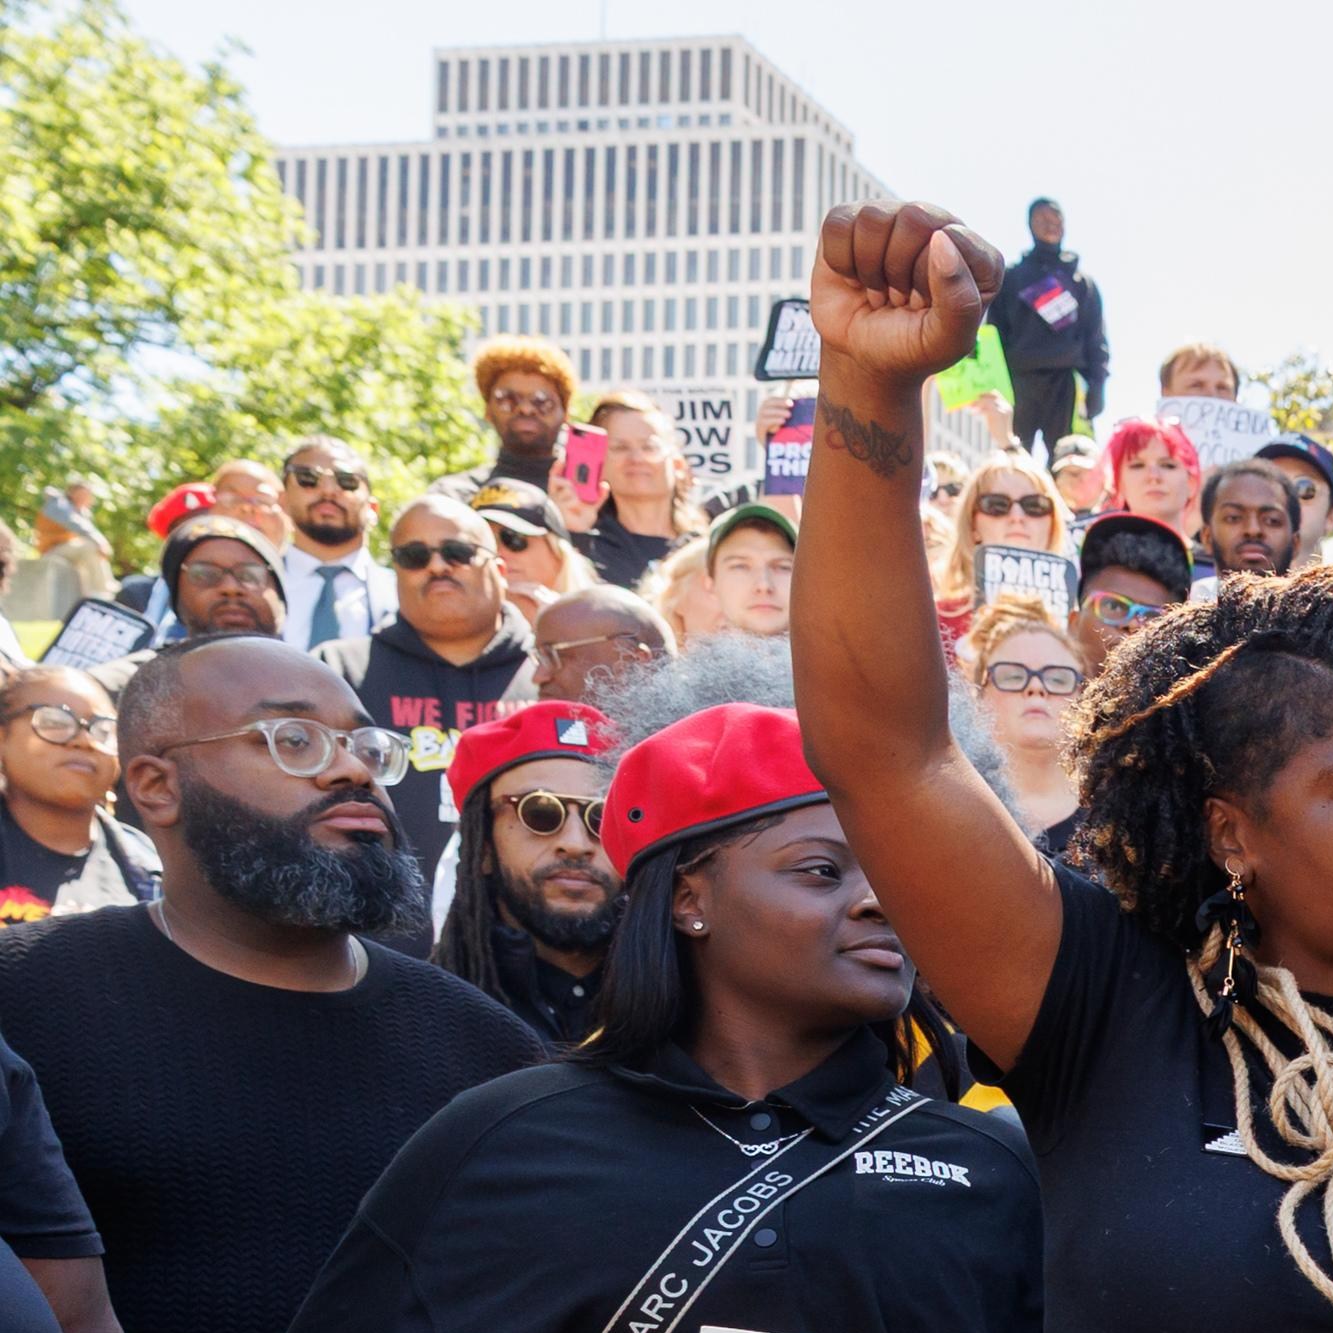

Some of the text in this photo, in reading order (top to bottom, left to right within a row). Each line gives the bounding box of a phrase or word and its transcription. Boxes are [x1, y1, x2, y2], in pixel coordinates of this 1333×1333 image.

[674, 400, 732, 421] JIM
[391, 696, 442, 730] WE
[854, 1150, 971, 1187] REEBOK
[691, 1170, 794, 1267] JACOBS
